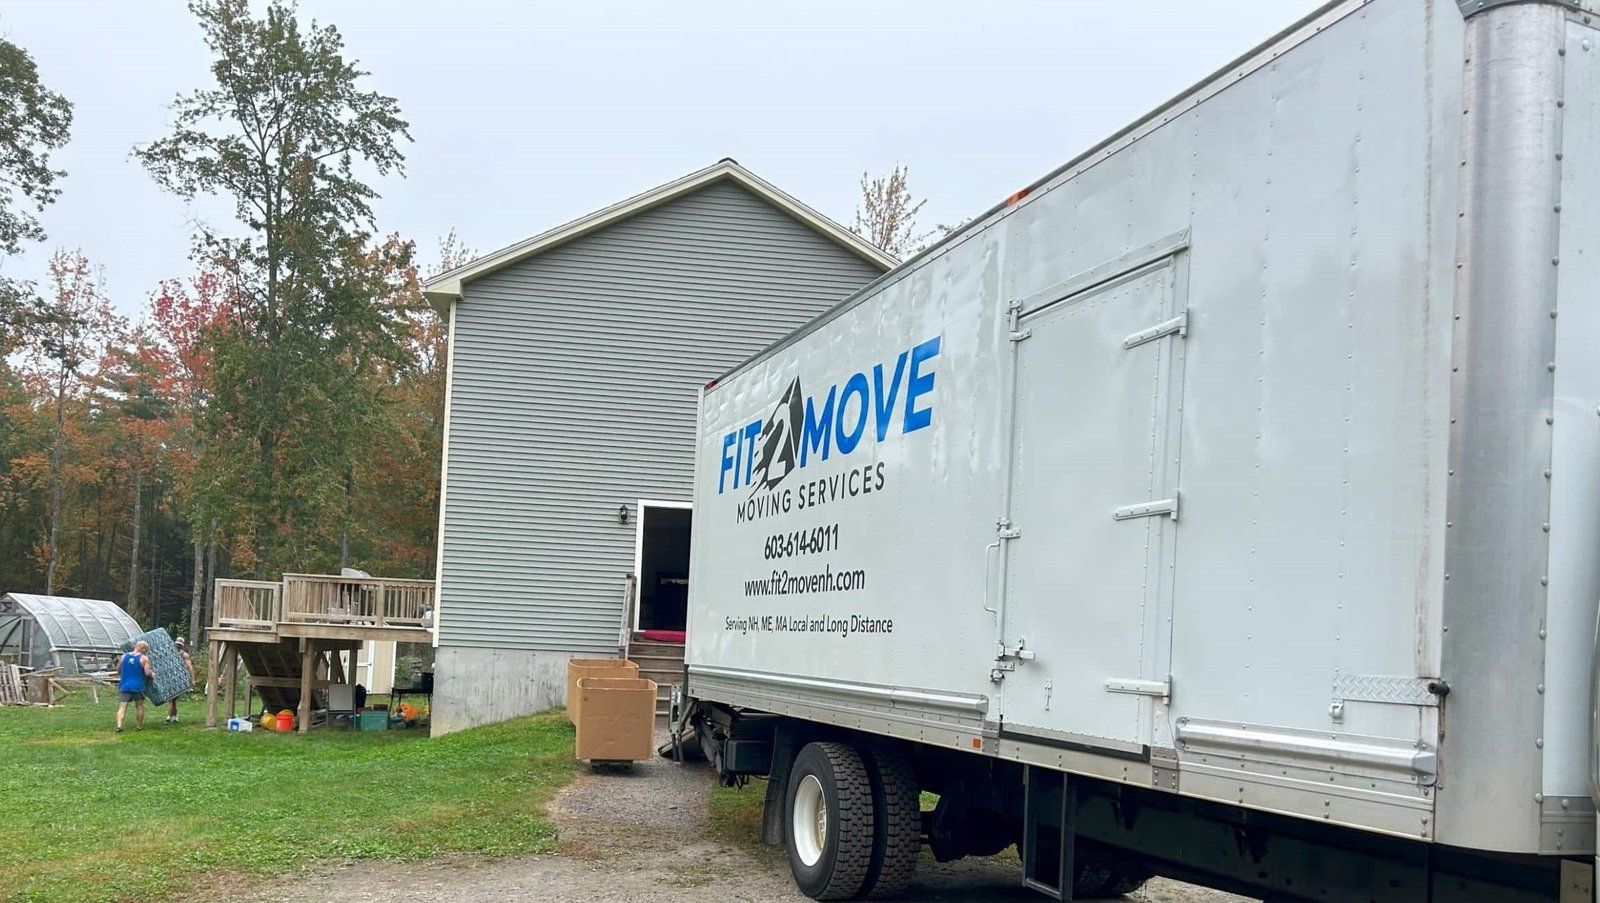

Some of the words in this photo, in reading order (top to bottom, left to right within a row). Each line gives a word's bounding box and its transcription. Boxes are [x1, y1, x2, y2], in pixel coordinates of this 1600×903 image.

[736, 490, 791, 524] MOVING
[798, 461, 885, 510] SERVICES
[764, 523, 839, 560] 603-614-6011
[744, 564, 865, 597] www.fit2movenh.com
[725, 616, 747, 635] Serving
[748, 616, 760, 633] NH,
[760, 616, 774, 633] ME,
[775, 616, 788, 632] MA
[789, 614, 808, 632] Local
[809, 614, 825, 632] and
[826, 615, 848, 638] Long
[850, 614, 893, 633] Distance
